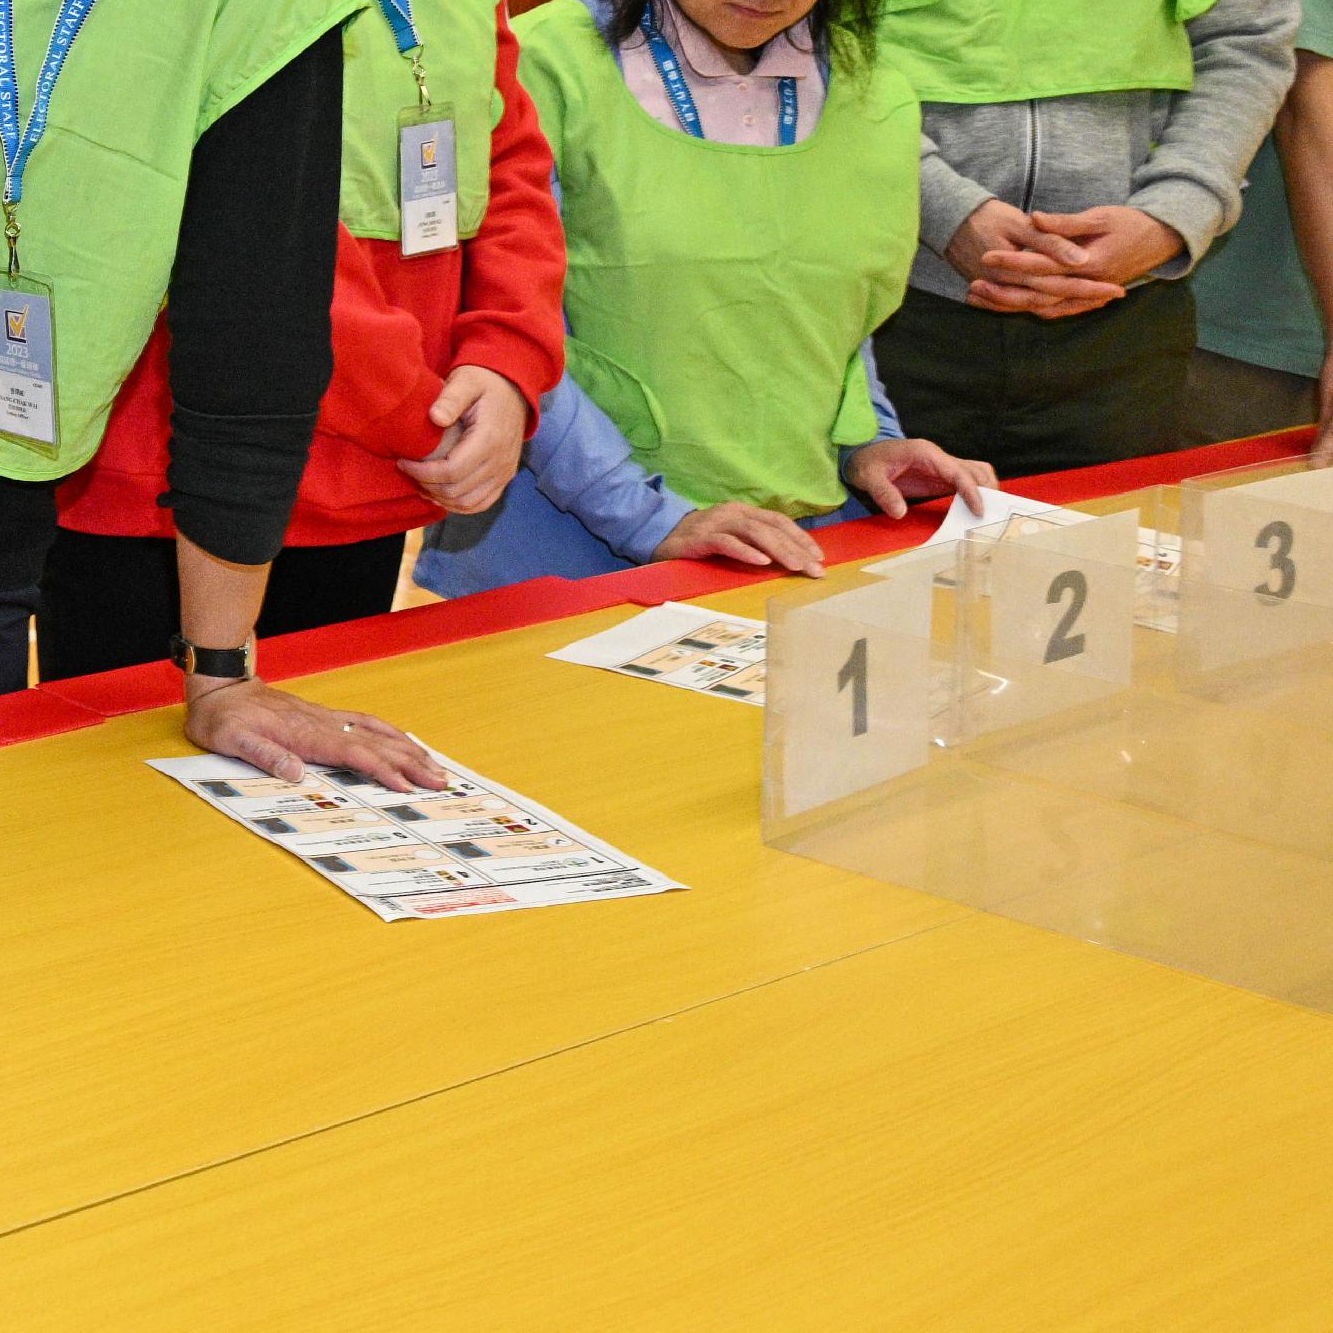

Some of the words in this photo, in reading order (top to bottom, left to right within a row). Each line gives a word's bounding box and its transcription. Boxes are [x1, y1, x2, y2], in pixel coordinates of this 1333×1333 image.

[30, 50, 63, 142] ELECTORAL
[57, 0, 84, 46] STAFF
[0, 92, 17, 140] STAFF
[6, 343, 28, 358] 2023
[1254, 520, 1297, 600] 3
[1044, 569, 1088, 665] 2
[837, 637, 868, 737] 1
